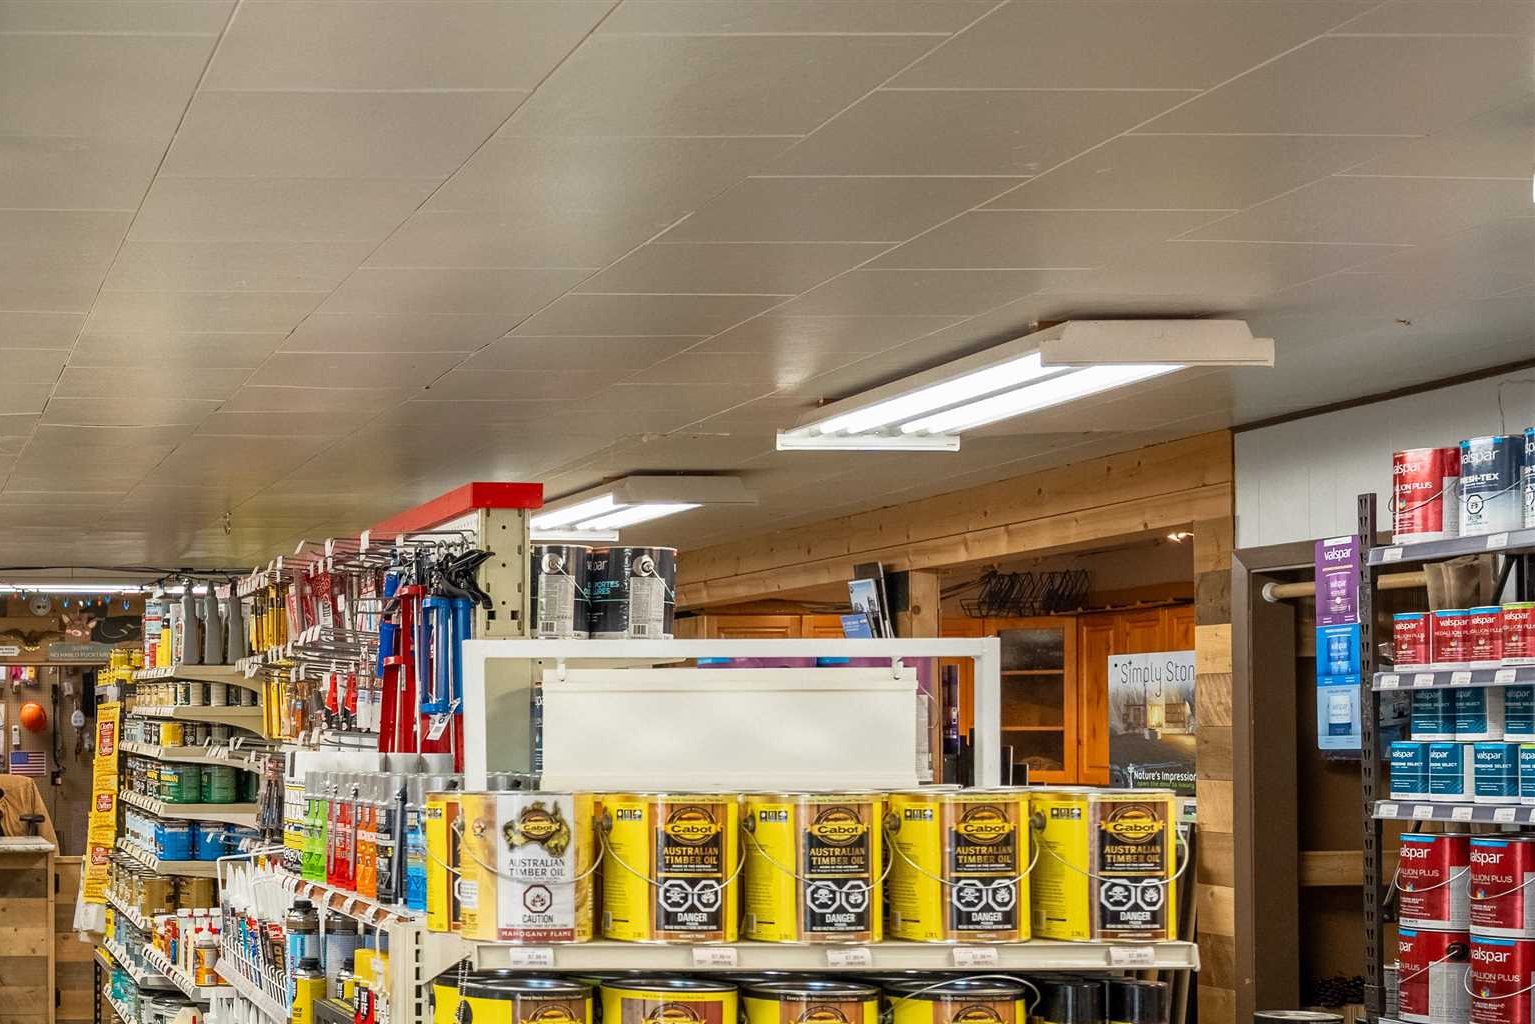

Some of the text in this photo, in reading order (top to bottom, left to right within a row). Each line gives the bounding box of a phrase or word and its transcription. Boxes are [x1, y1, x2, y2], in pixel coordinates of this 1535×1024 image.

[1324, 547, 1353, 562] valspar
[1121, 659, 1196, 698] Simply Ston
[523, 823, 553, 832] Cabot
[671, 824, 712, 834] Cabot
[822, 824, 863, 834] Cabot
[964, 823, 1006, 833] Cabot
[1113, 822, 1154, 832] Cabot
[663, 846, 719, 856] AUSTRALIAN
[809, 846, 865, 856] AUSTRALIAN
[956, 846, 1012, 855] AUSTRALIAN
[1104, 846, 1161, 855] AUSTRALIAN
[509, 858, 565, 867] AUSTRALIAN
[664, 855, 718, 865] TIMBER OIL
[810, 856, 865, 865] TIMBER OIL
[957, 854, 1012, 863] TIMBER OIL
[1105, 854, 1160, 863] TIMBER OIL
[509, 868, 565, 877] TIMBER OIL
[522, 914, 553, 924] CAUTION
[678, 913, 707, 922] DANGER
[825, 913, 855, 923] DANGER
[971, 911, 1002, 921] DANGER
[1120, 911, 1151, 921] DANGER
[501, 930, 571, 938] MAHOGANY FLAME
